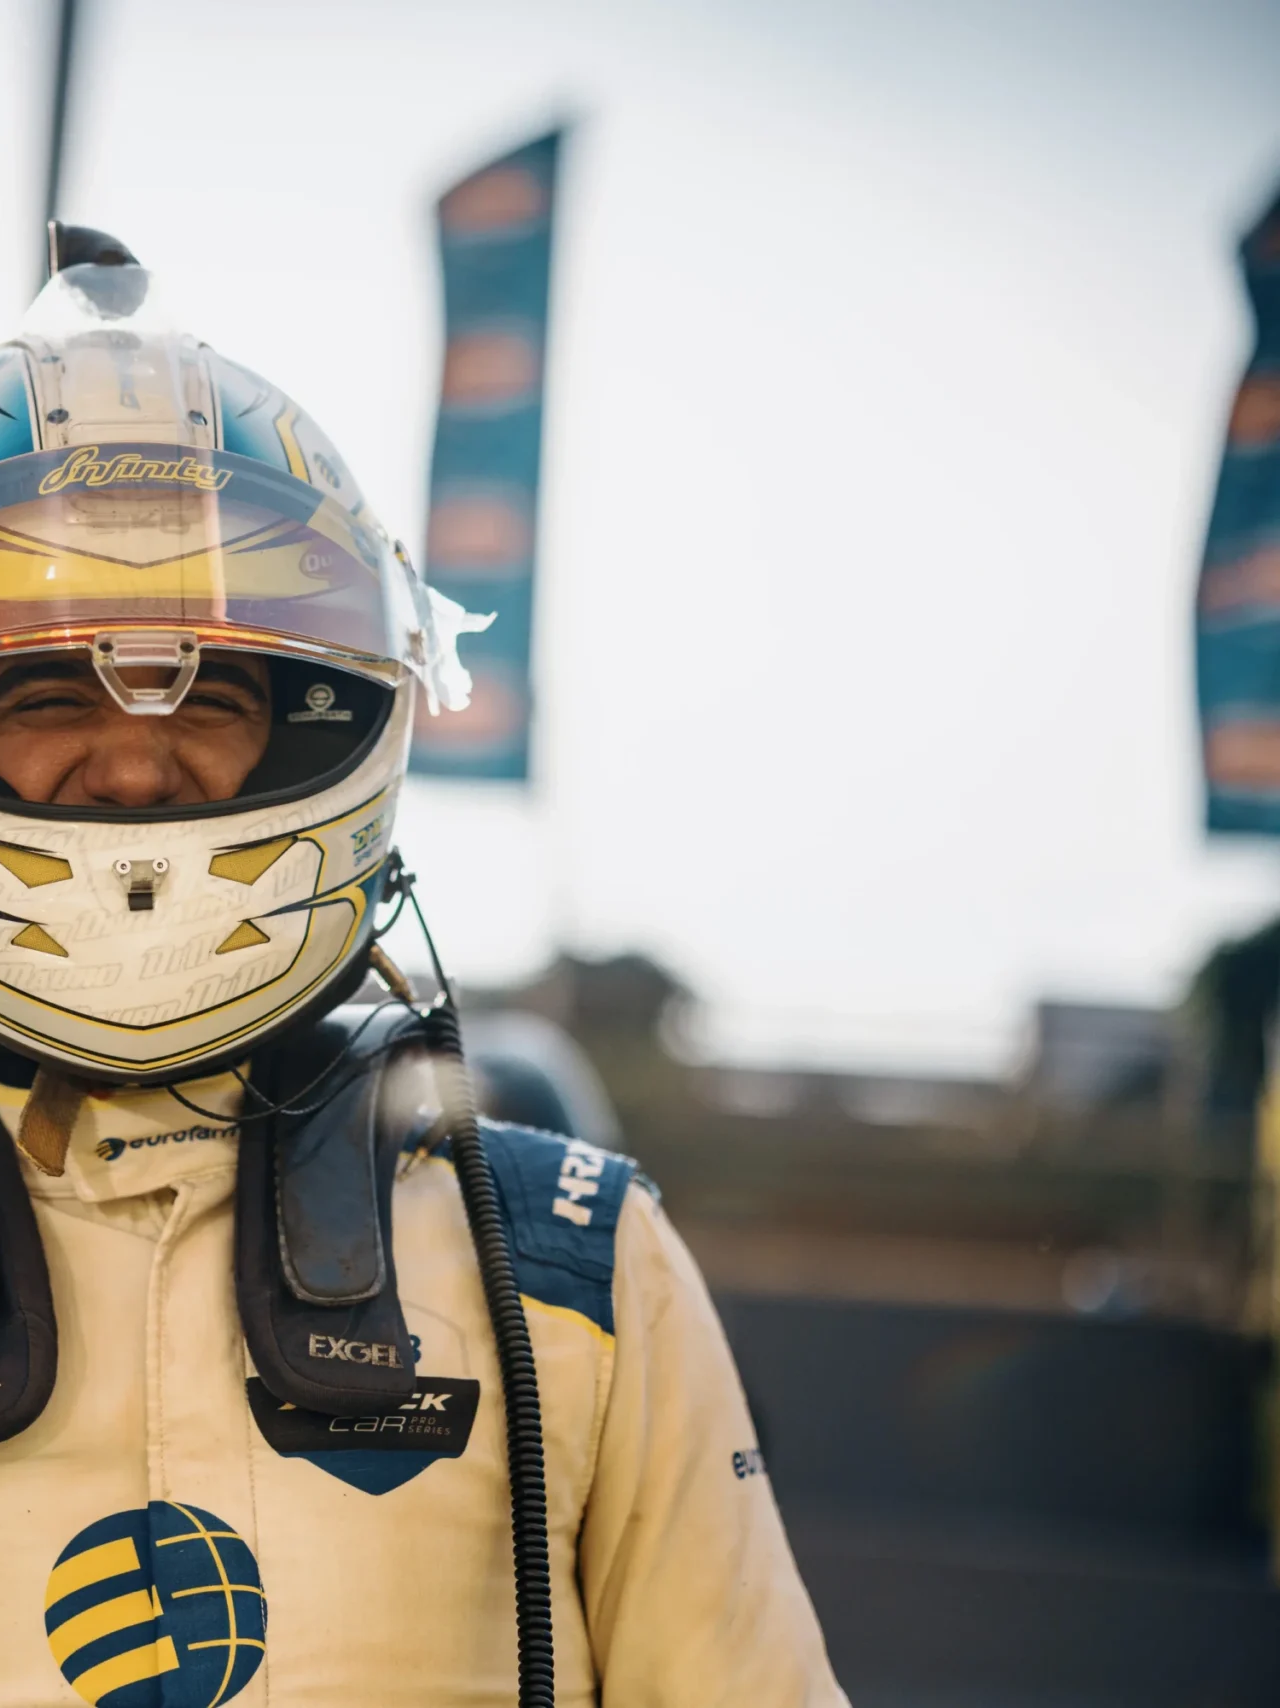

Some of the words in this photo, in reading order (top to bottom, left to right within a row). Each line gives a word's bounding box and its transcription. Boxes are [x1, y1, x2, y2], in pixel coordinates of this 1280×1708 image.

[308, 1333, 405, 1369] EXGEL
[410, 1416, 437, 1425] PRO
[408, 1425, 452, 1436] SERIES
